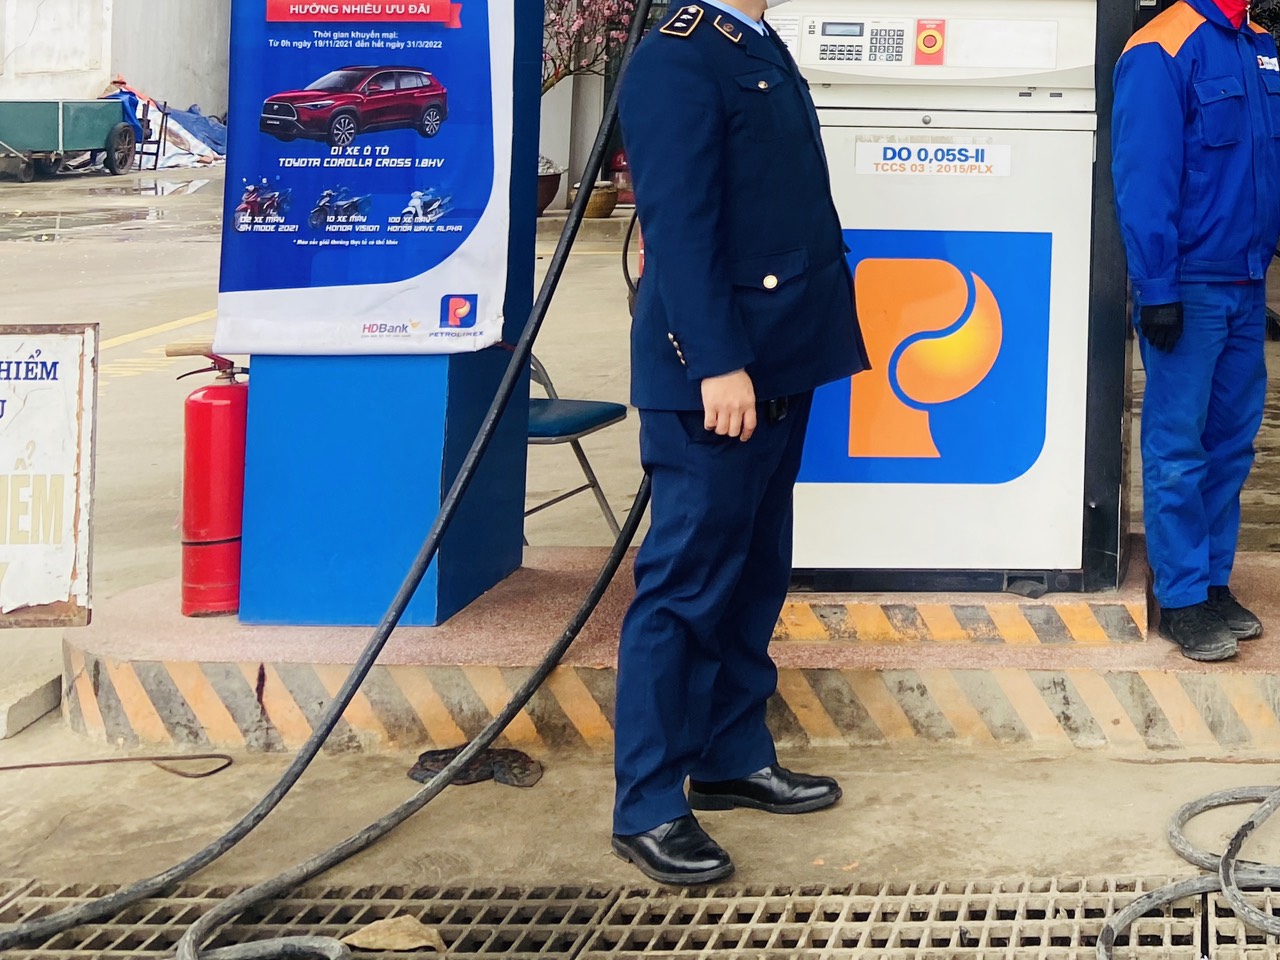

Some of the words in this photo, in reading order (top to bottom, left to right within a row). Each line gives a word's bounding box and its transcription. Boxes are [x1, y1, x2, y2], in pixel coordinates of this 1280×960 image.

[342, 3, 382, 14] NHIỀU
[385, 4, 405, 14] ƯU
[408, 2, 430, 14] ĐÃI
[333, 30, 349, 40] gian
[345, 146, 360, 156] XE
[374, 144, 390, 156] TÔ
[882, 146, 912, 162] DO
[917, 147, 985, 164] 0,05S-II
[278, 157, 321, 168] TOYOTA
[323, 157, 373, 168] COROLLA
[375, 158, 412, 168] CROSS
[414, 158, 445, 168] 1.8HV
[873, 162, 907, 172] TCCS
[910, 163, 925, 173] 03
[936, 164, 993, 174] 2015/PLX
[325, 224, 353, 232] HONDA
[354, 224, 380, 232] VISION
[362, 323, 408, 333] HDBank
